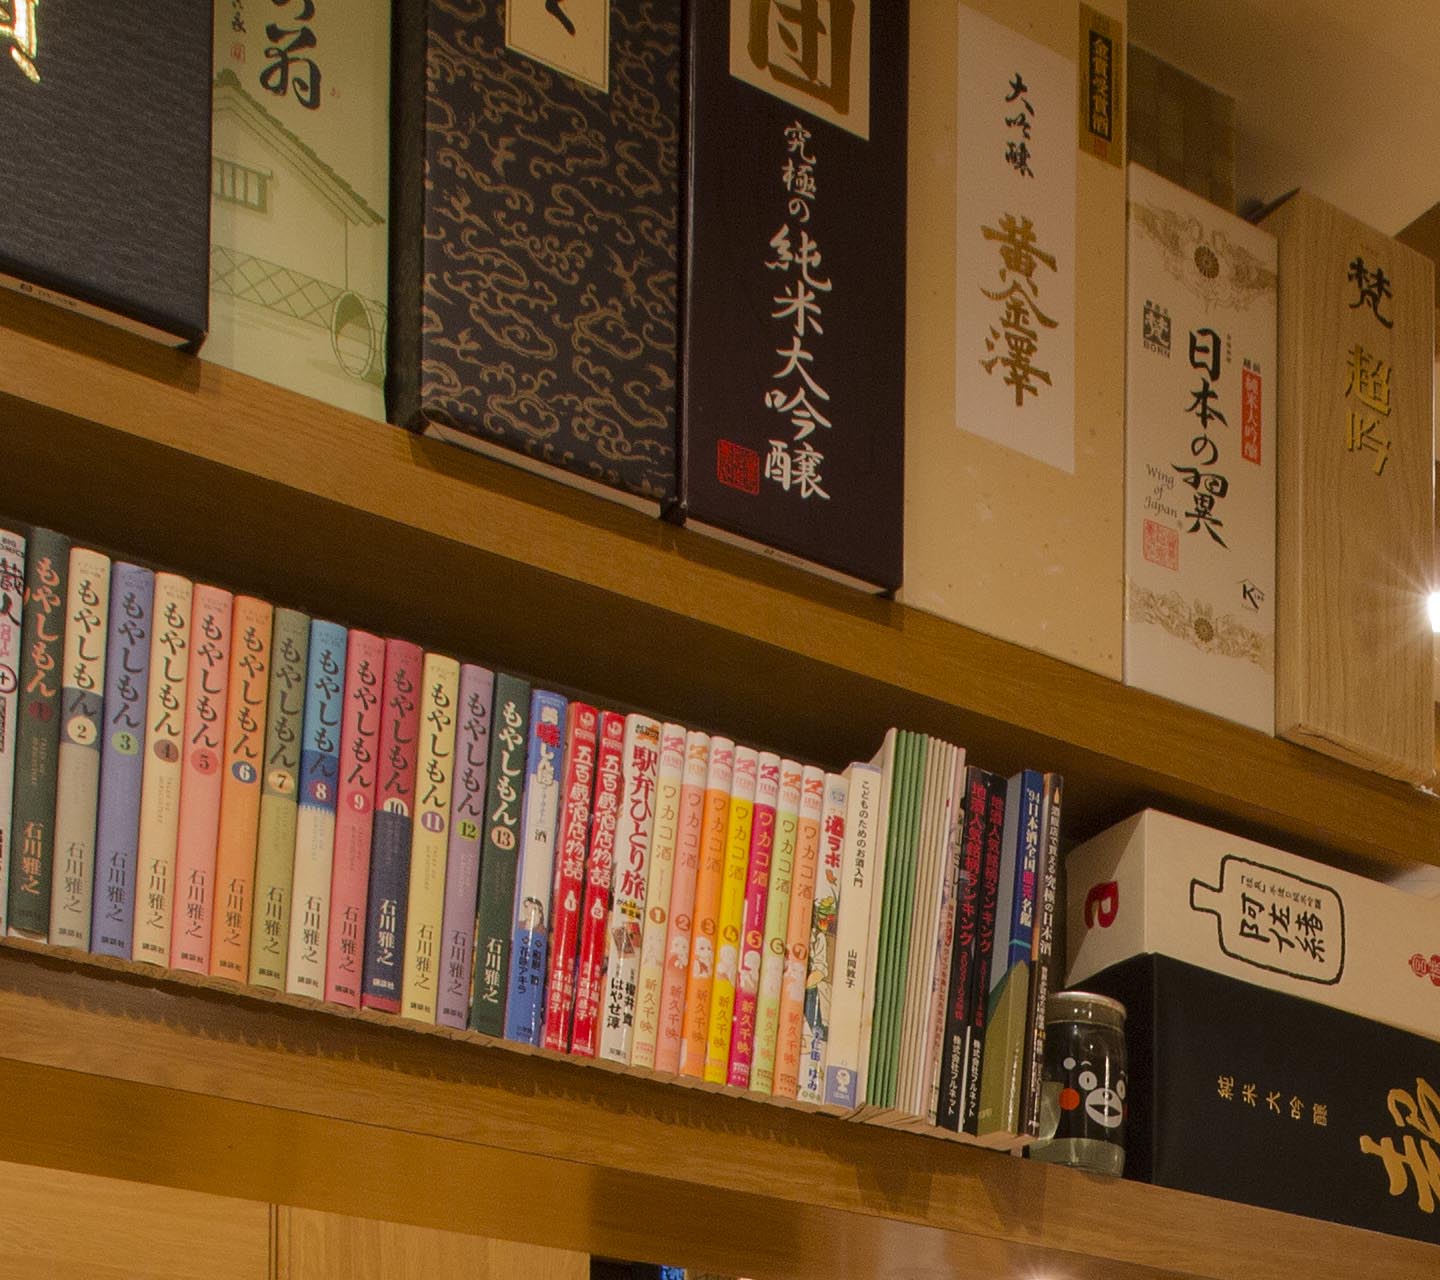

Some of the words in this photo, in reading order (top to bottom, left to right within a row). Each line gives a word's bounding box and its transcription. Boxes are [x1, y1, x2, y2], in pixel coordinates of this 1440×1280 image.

[1004, 72, 1034, 178] 大吟醸
[764, 120, 832, 500] 究極の純米大吟醸
[980, 212, 1058, 406] 黄金澤
[1348, 256, 1394, 330] 梵
[1145, 463, 1176, 488] Wing
[1171, 327, 1229, 549] 日本の翼
[1144, 495, 1178, 519] Japan
[1154, 485, 1164, 501] of
[421, 683, 452, 809] もやしもん
[490, 700, 523, 826] もやしもん
[620, 745, 657, 901] 駅弁ひとり旅
[852, 781, 872, 888] こどものためのお酒入門
[1217, 1075, 1328, 1127] 純米大吟醸
